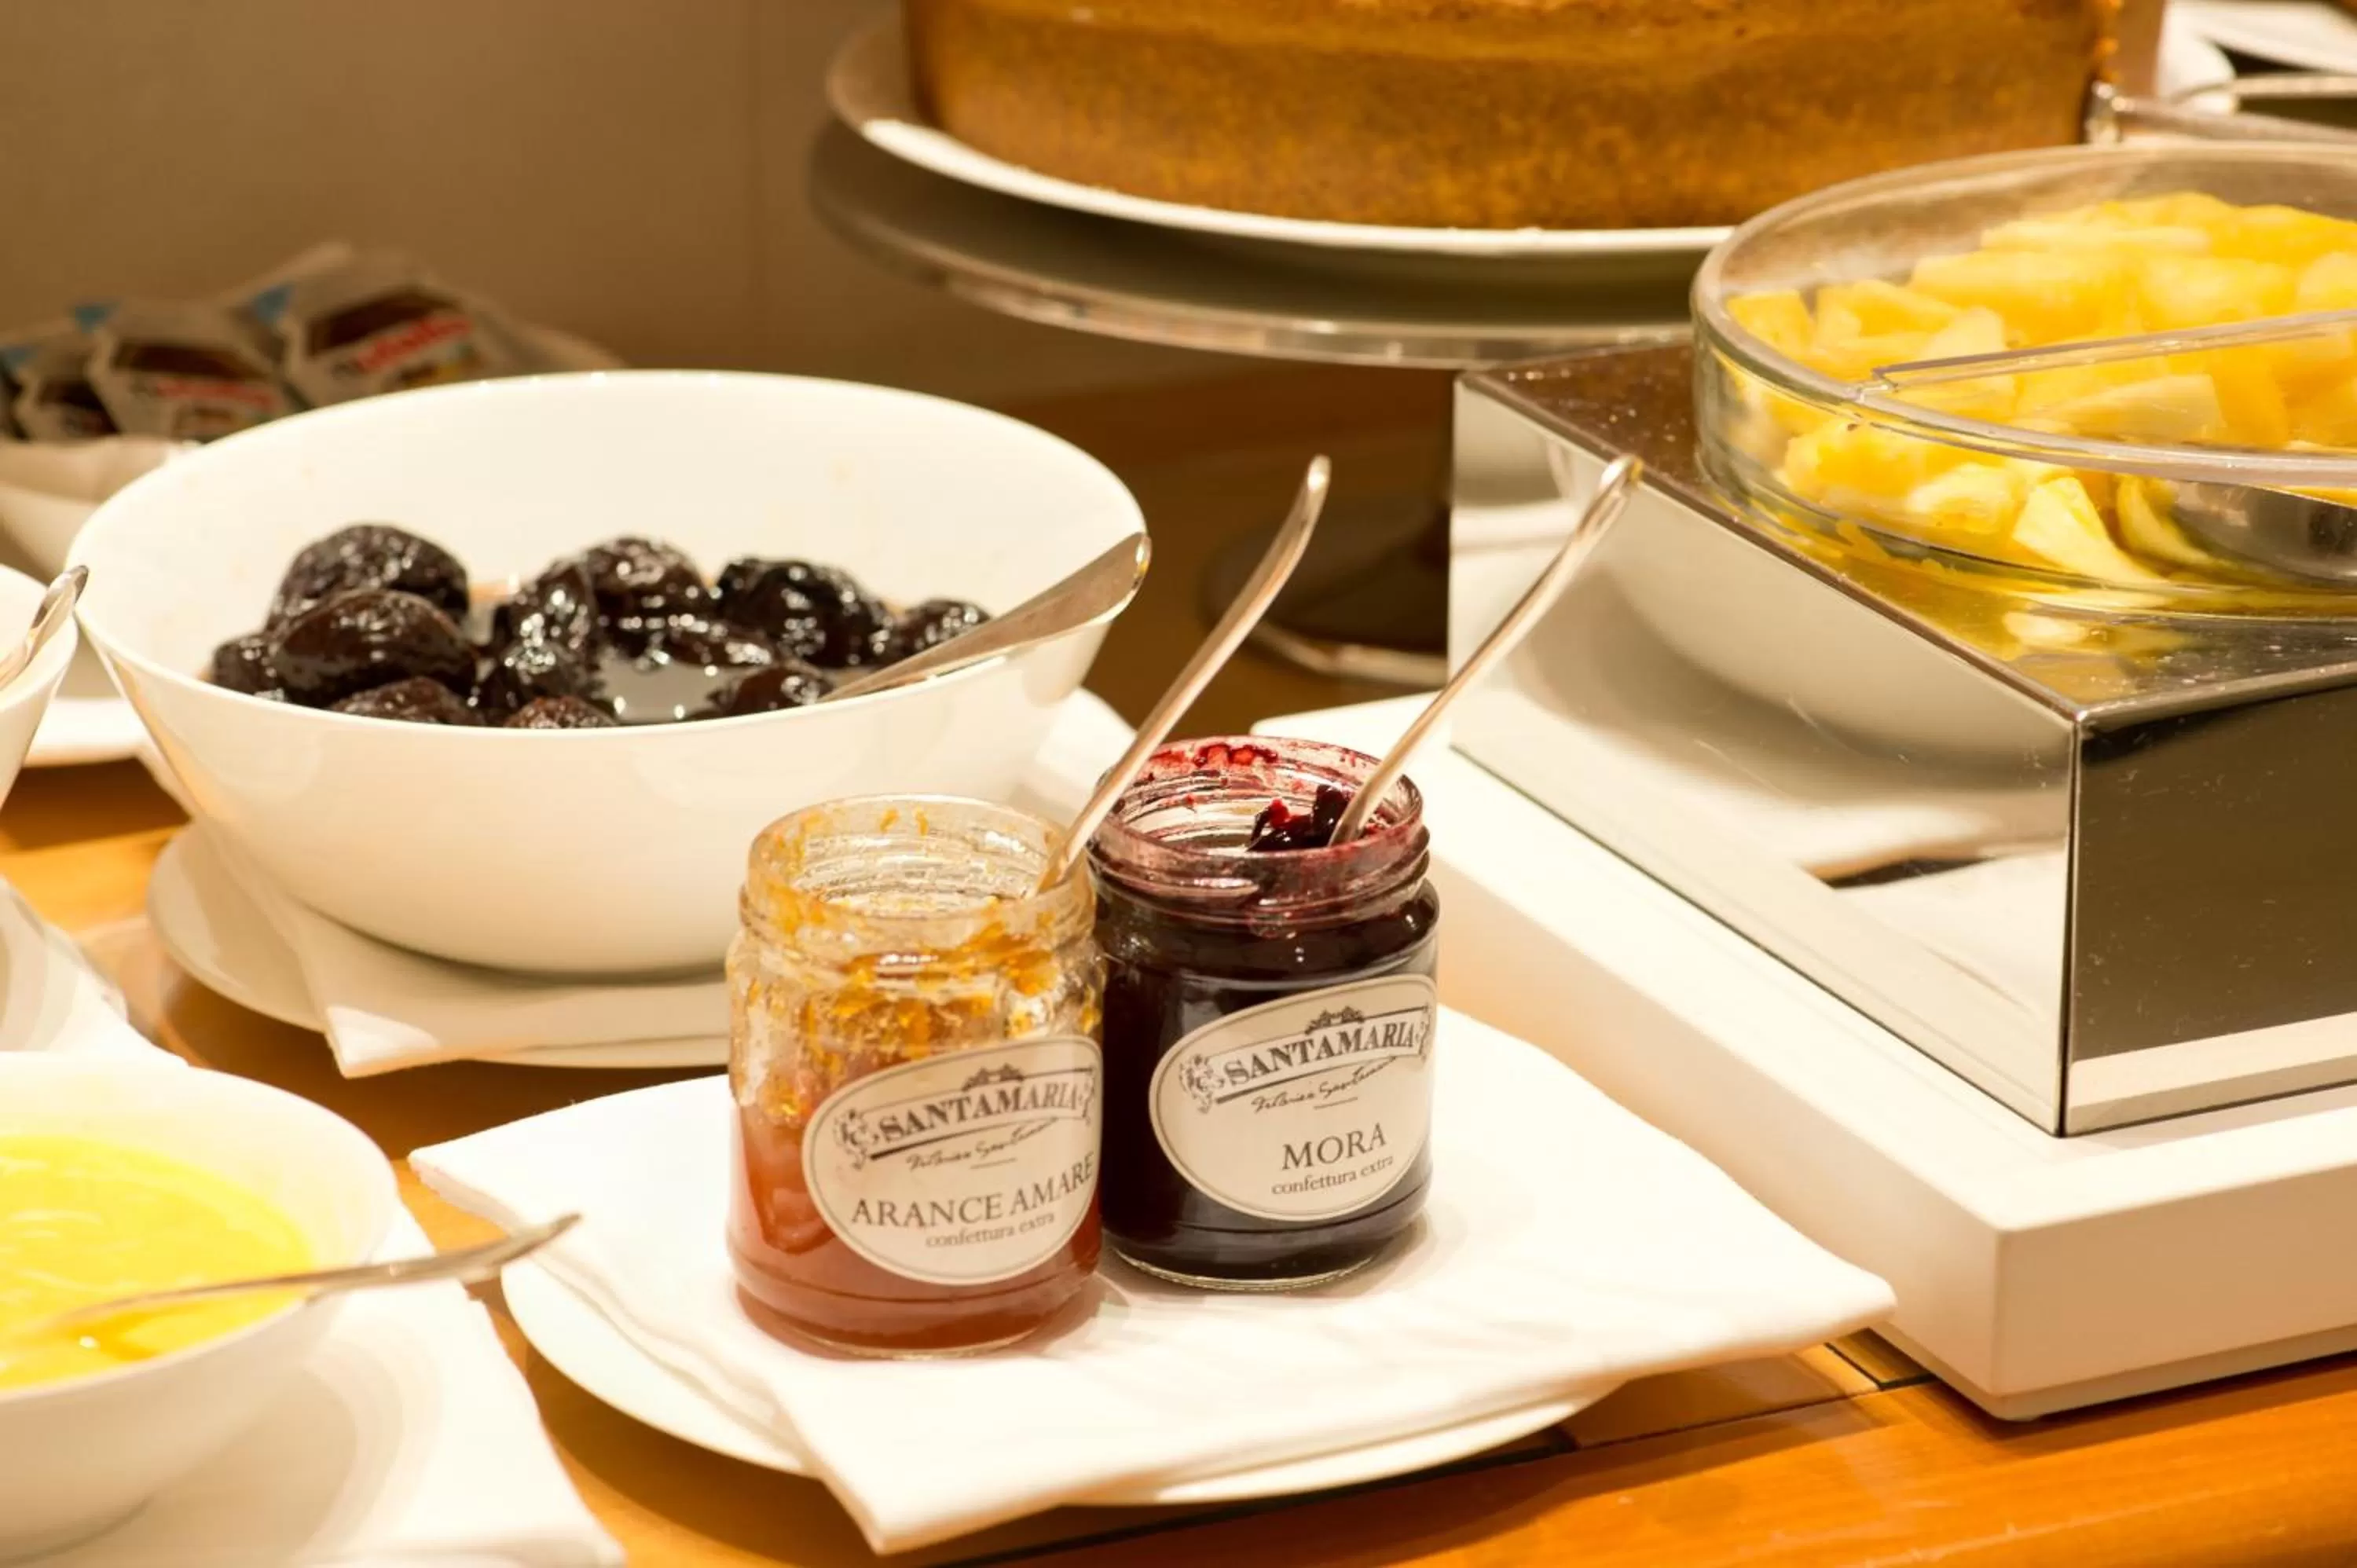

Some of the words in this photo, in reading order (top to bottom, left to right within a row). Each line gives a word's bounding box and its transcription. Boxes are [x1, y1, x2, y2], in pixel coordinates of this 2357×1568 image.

[1223, 1021, 1416, 1086] SANTAMARIA
[878, 1082, 1078, 1145] SANTAMARIA
[1281, 1123, 1387, 1171] MORA
[851, 1193, 1003, 1229] ARANCE
[1009, 1151, 1094, 1217] AMARE
[1271, 1170, 1358, 1196] confettura
[1361, 1155, 1395, 1177] extra
[925, 1224, 1015, 1248] confettura
[1018, 1211, 1055, 1235] extra
